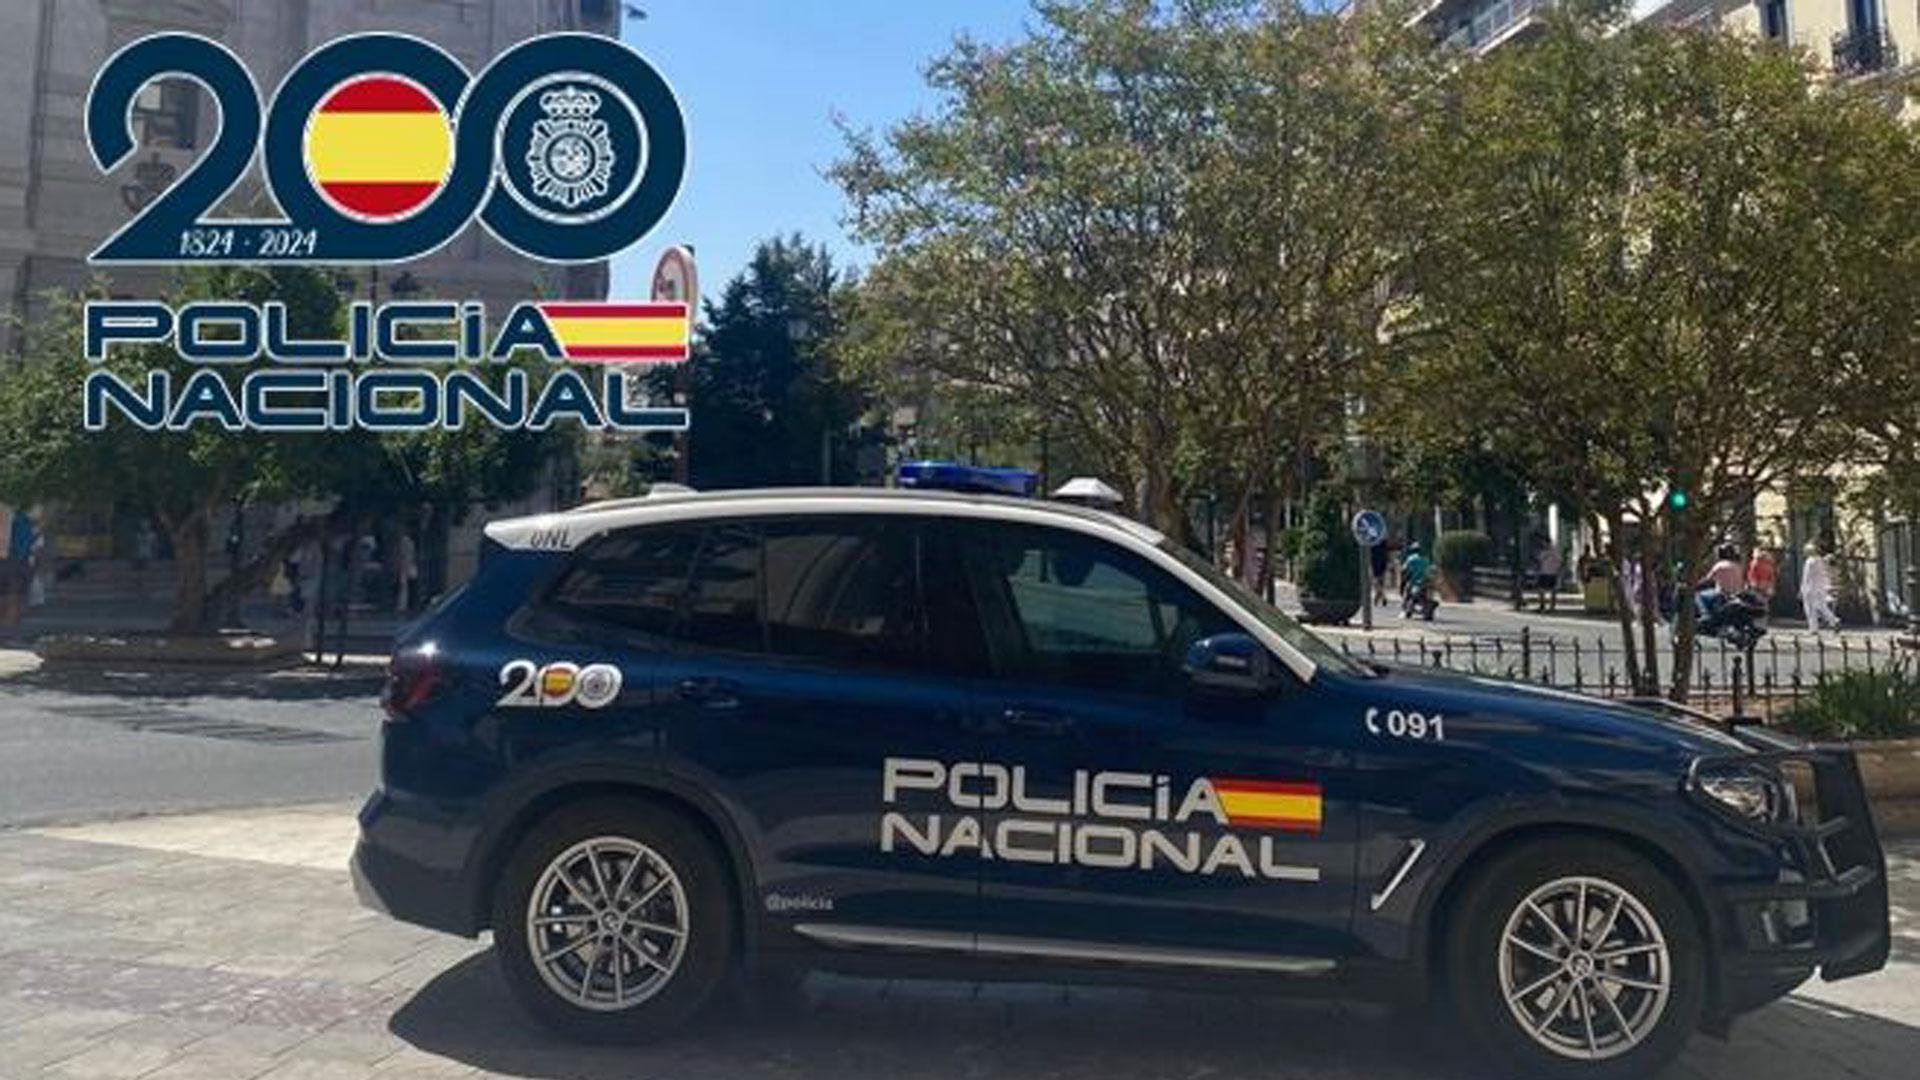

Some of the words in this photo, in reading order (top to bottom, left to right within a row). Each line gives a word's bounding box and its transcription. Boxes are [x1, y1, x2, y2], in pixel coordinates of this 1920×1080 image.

[496, 659, 623, 709] 200
[1387, 709, 1443, 741] 091
[880, 812, 1320, 881] NACIONAL
